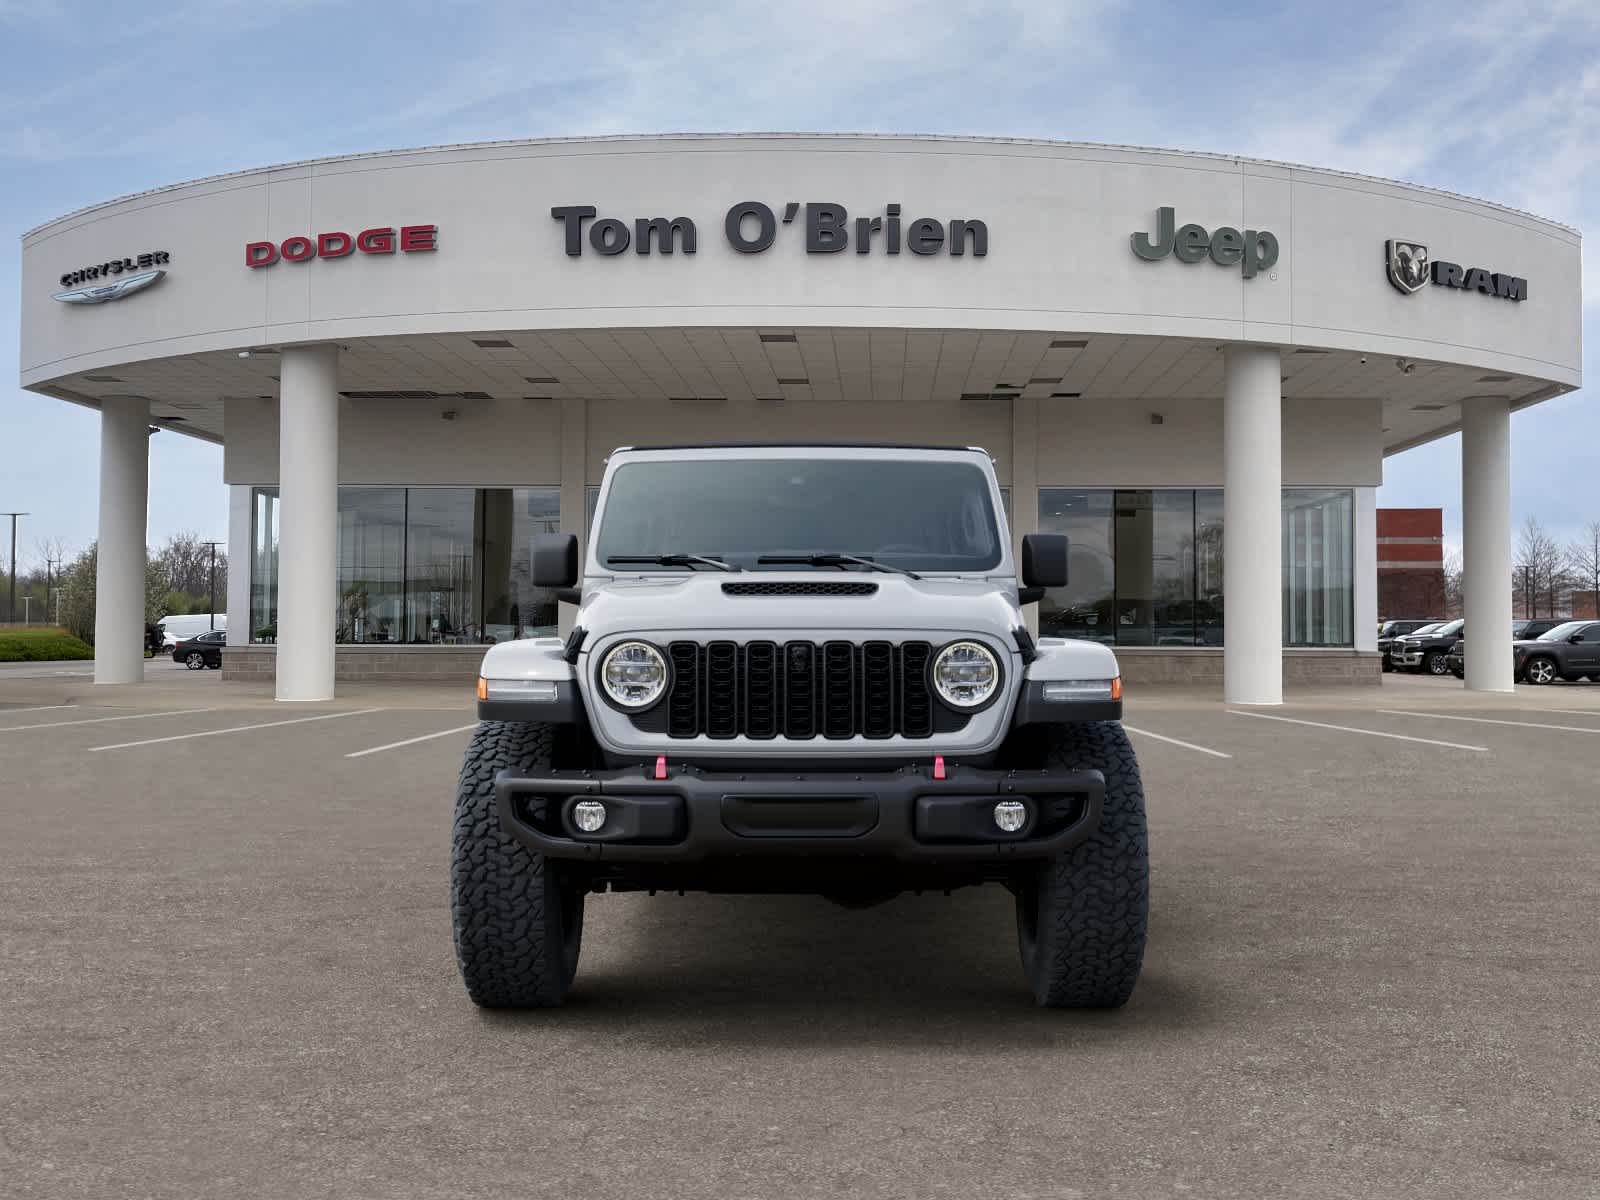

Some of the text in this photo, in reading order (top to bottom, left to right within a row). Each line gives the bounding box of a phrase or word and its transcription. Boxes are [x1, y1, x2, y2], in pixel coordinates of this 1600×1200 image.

[245, 225, 437, 269] DODGE
[551, 201, 989, 257] Tom O'Brien
[1130, 206, 1279, 279] Jeep
[60, 250, 170, 287] CHRYSLER
[1431, 260, 1528, 301] RAM
